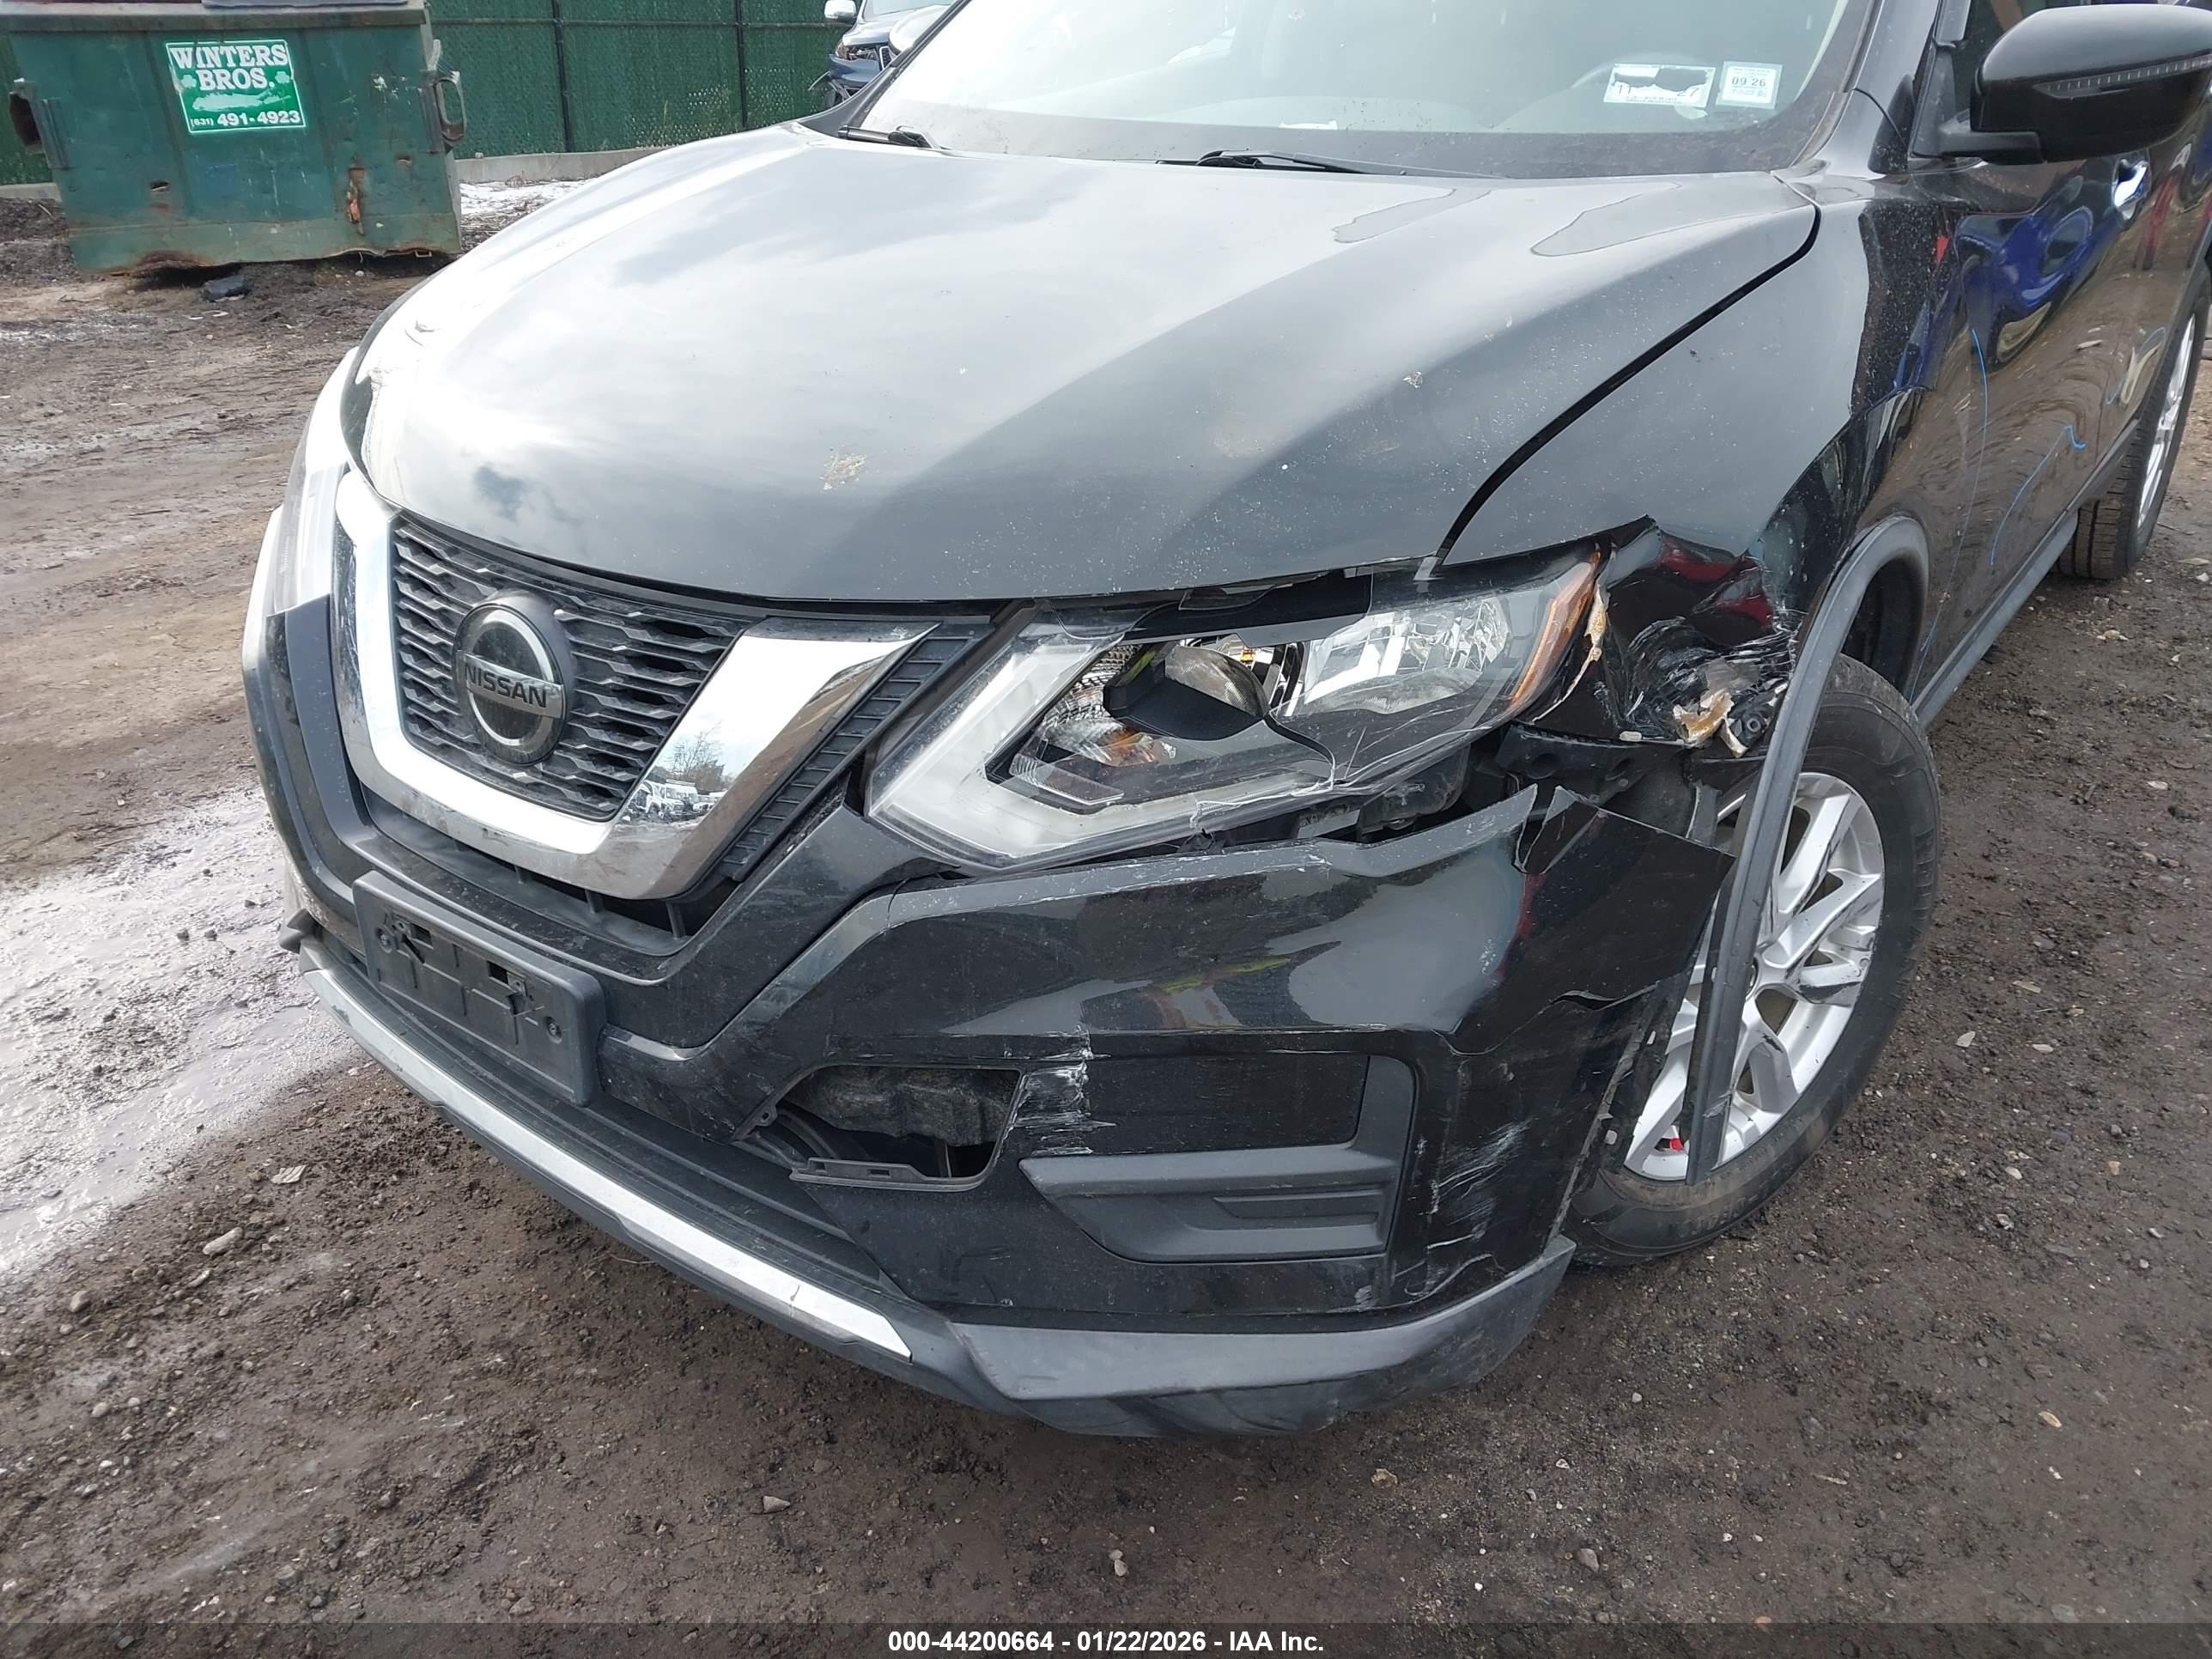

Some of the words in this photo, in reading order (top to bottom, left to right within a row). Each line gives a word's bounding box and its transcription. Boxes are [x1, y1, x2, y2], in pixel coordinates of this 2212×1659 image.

[170, 44, 289, 69] WINTERS
[196, 68, 276, 90] BROS.
[1732, 76, 1747, 86] 09
[1752, 77, 1766, 88] 26
[191, 118, 214, 128] (631)
[217, 110, 301, 126] 491-4923
[465, 663, 546, 708] NISSAN
